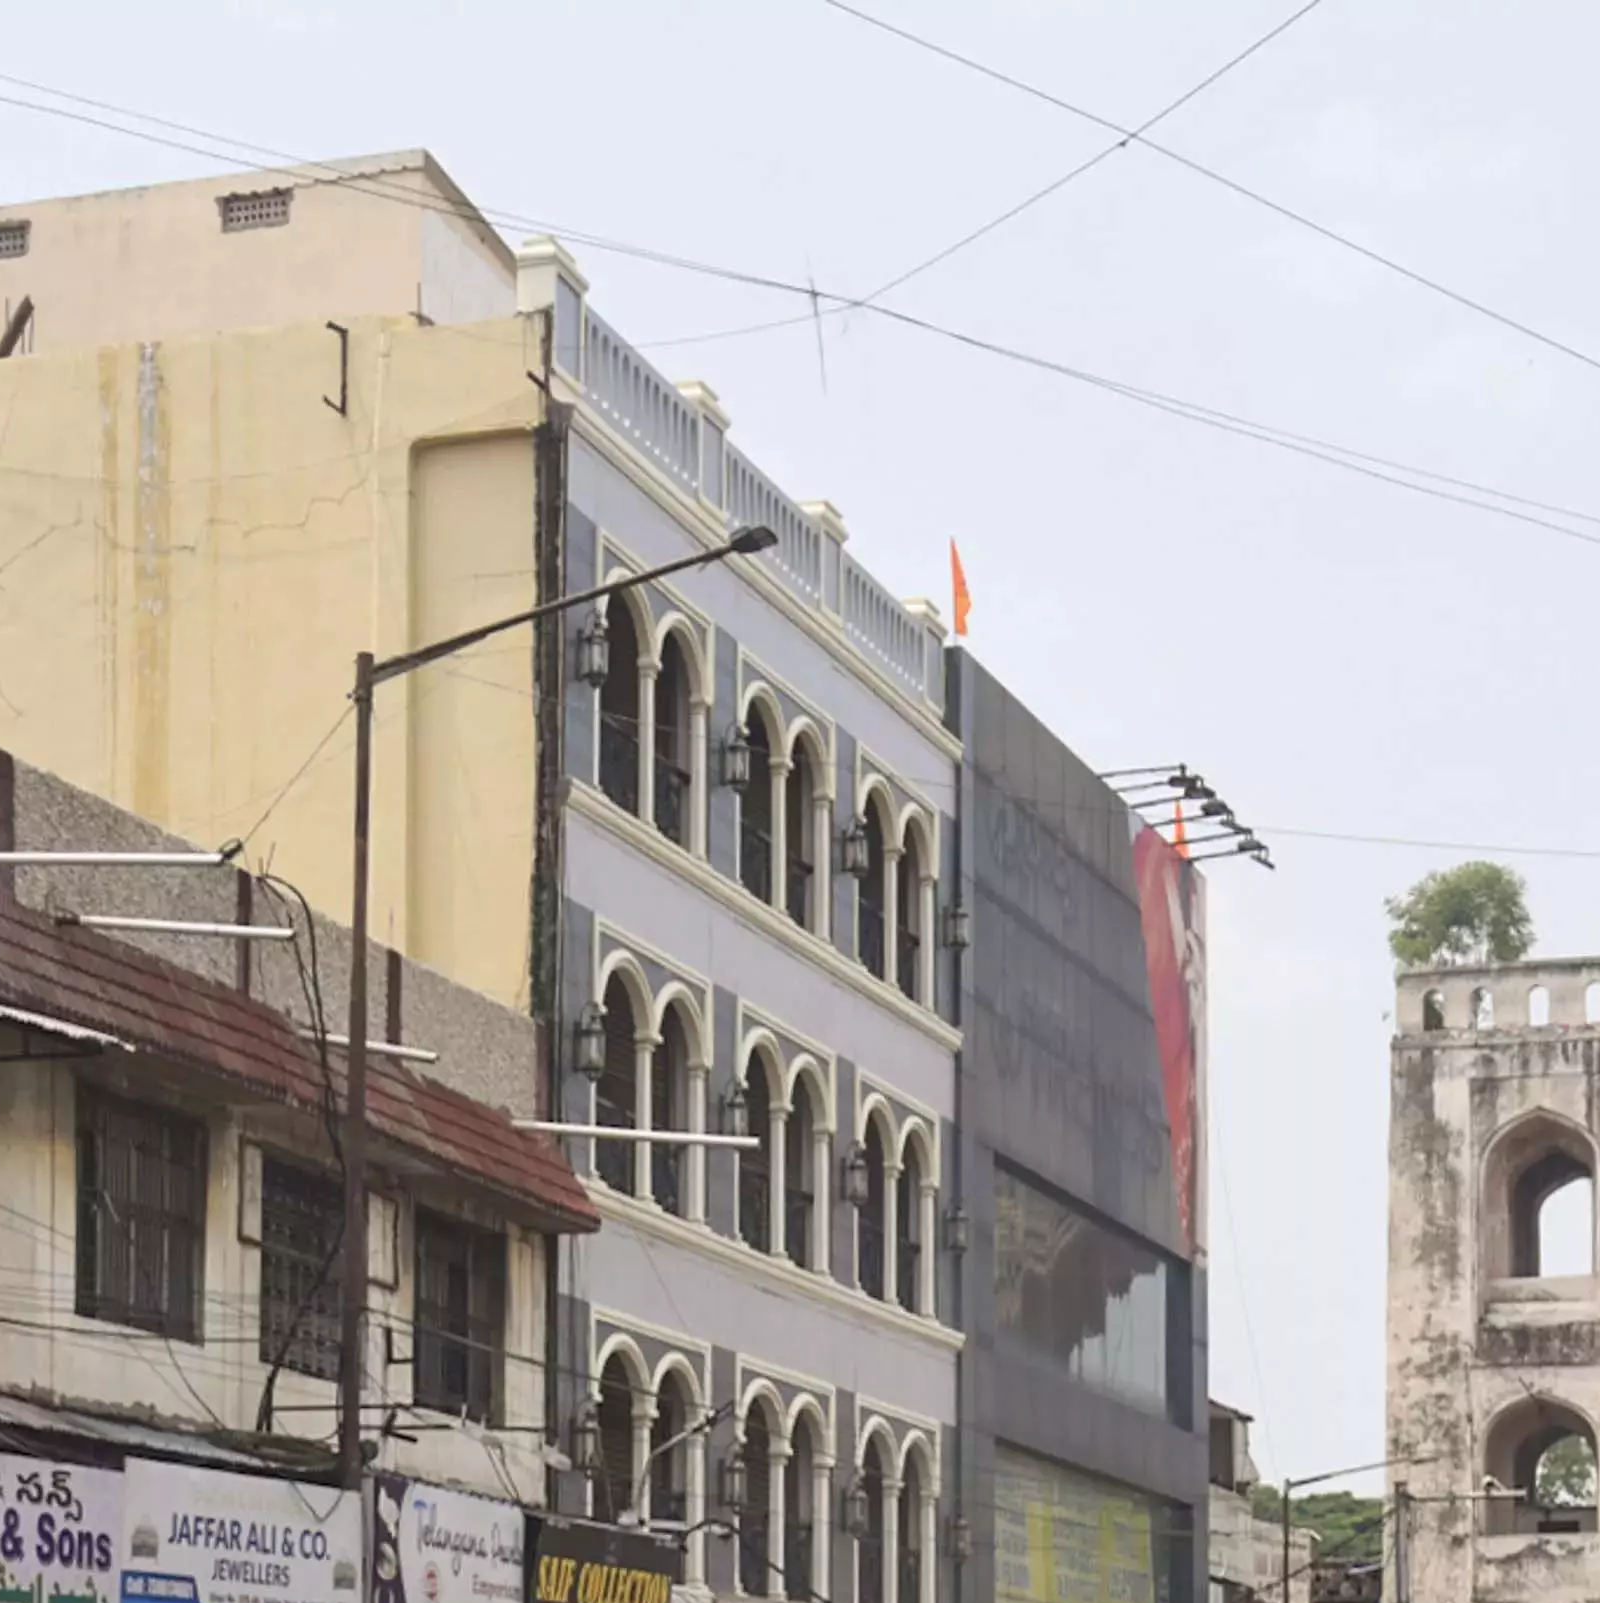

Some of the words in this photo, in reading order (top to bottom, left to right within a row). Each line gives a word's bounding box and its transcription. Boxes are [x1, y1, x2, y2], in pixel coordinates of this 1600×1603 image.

[0, 1507, 24, 1562] &
[36, 1512, 113, 1572] Sons
[167, 1512, 242, 1551] JAFFAR
[246, 1521, 278, 1557] ALI
[281, 1525, 296, 1558] &
[299, 1529, 331, 1561] CO.
[211, 1558, 291, 1588] JEWELLERS
